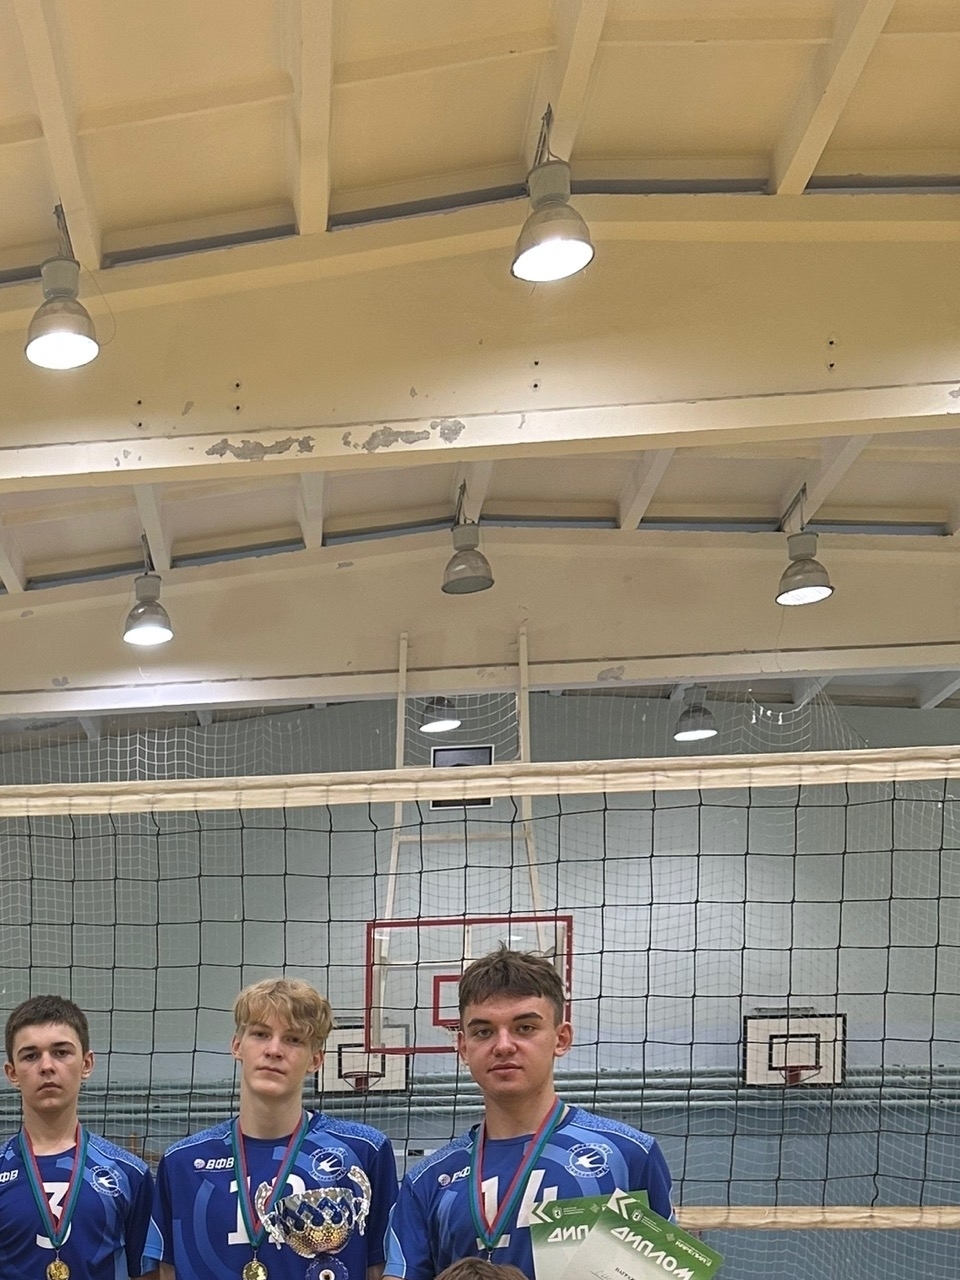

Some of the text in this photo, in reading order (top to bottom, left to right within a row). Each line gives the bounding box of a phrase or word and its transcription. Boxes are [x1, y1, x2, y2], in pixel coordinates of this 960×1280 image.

[205, 1157, 234, 1169] ВФВ
[36, 1182, 72, 1249] 3
[547, 1225, 589, 1242] ДИП
